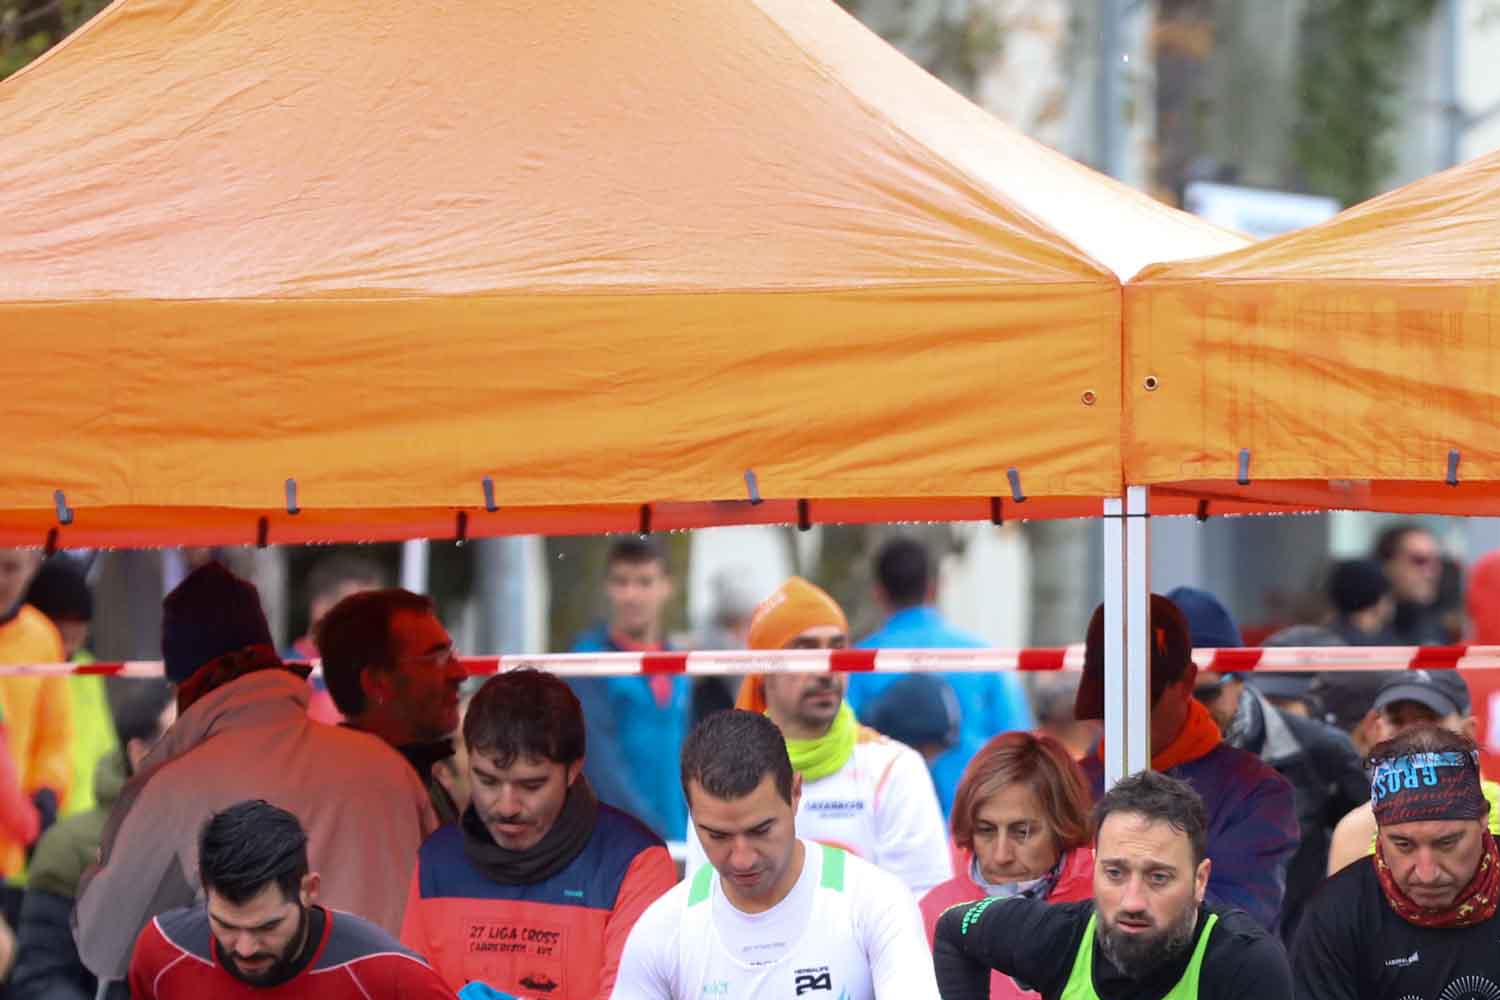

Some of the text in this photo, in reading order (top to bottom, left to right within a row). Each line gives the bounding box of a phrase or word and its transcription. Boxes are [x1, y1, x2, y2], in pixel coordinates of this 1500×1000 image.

[469, 926, 560, 944] 27 LIGA CROSS
[795, 972, 832, 996] 24
